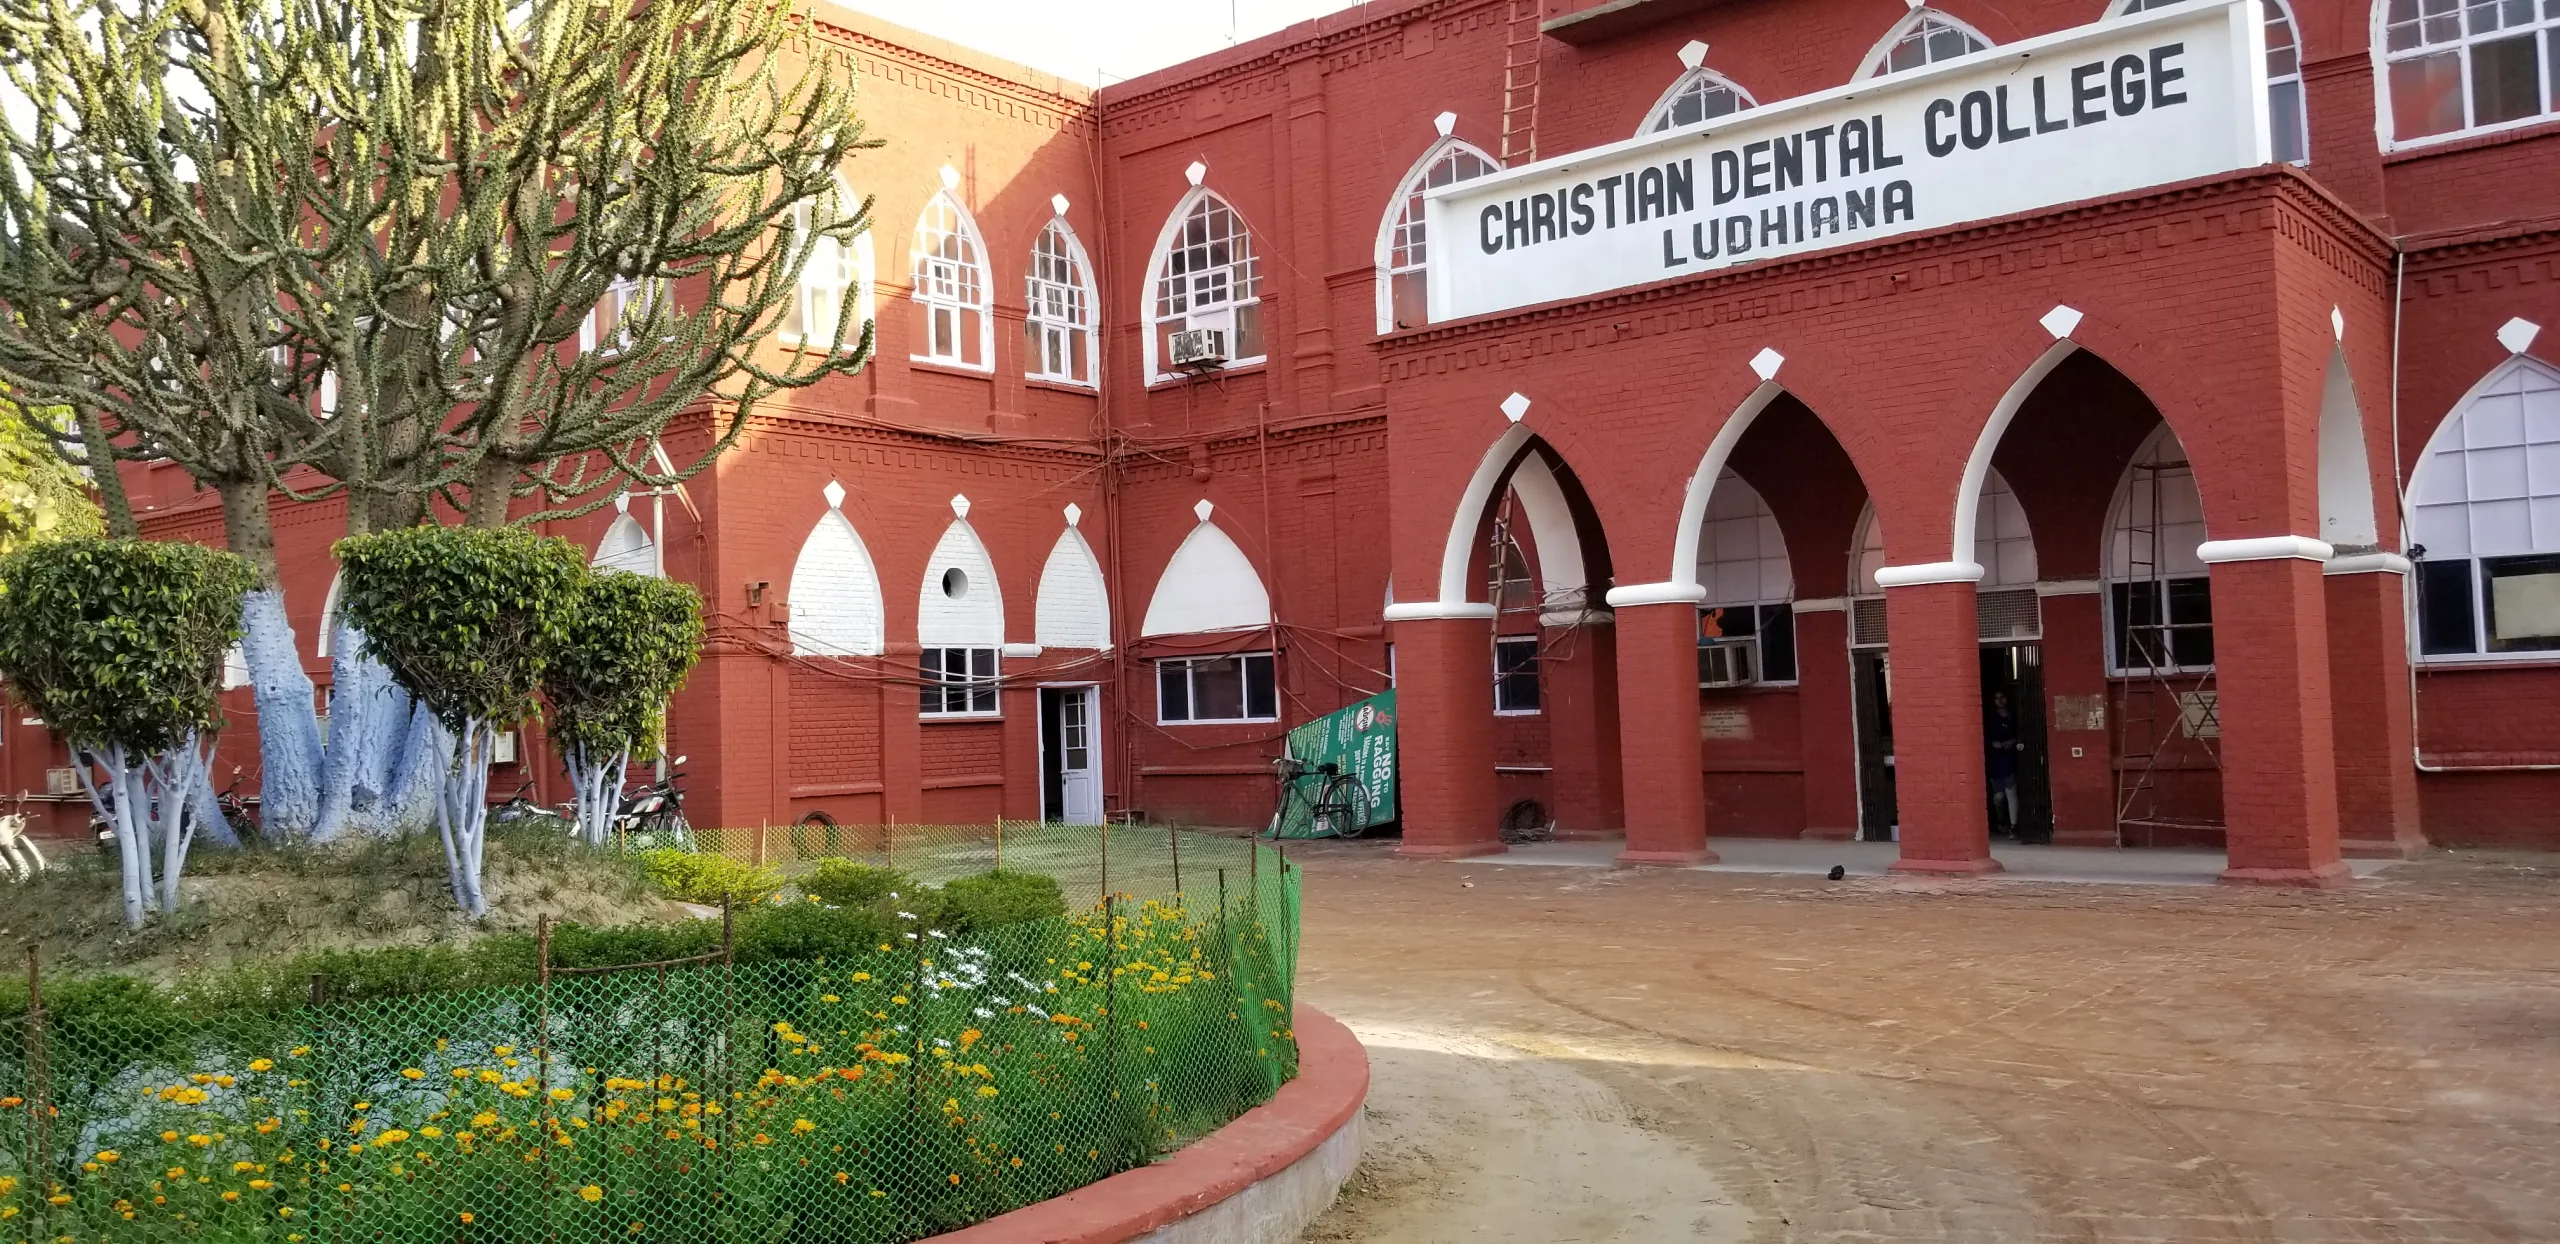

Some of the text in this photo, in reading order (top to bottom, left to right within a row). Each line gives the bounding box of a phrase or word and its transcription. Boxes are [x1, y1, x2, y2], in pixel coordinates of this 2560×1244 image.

[1480, 42, 2187, 255] CHRISTIAN DENTAL COLLEGE
[1663, 179, 1914, 268] LUDHIANA
[1371, 734, 1383, 808] RAGGING
[1381, 752, 1391, 781] NO
[1383, 782, 1388, 793] TO
